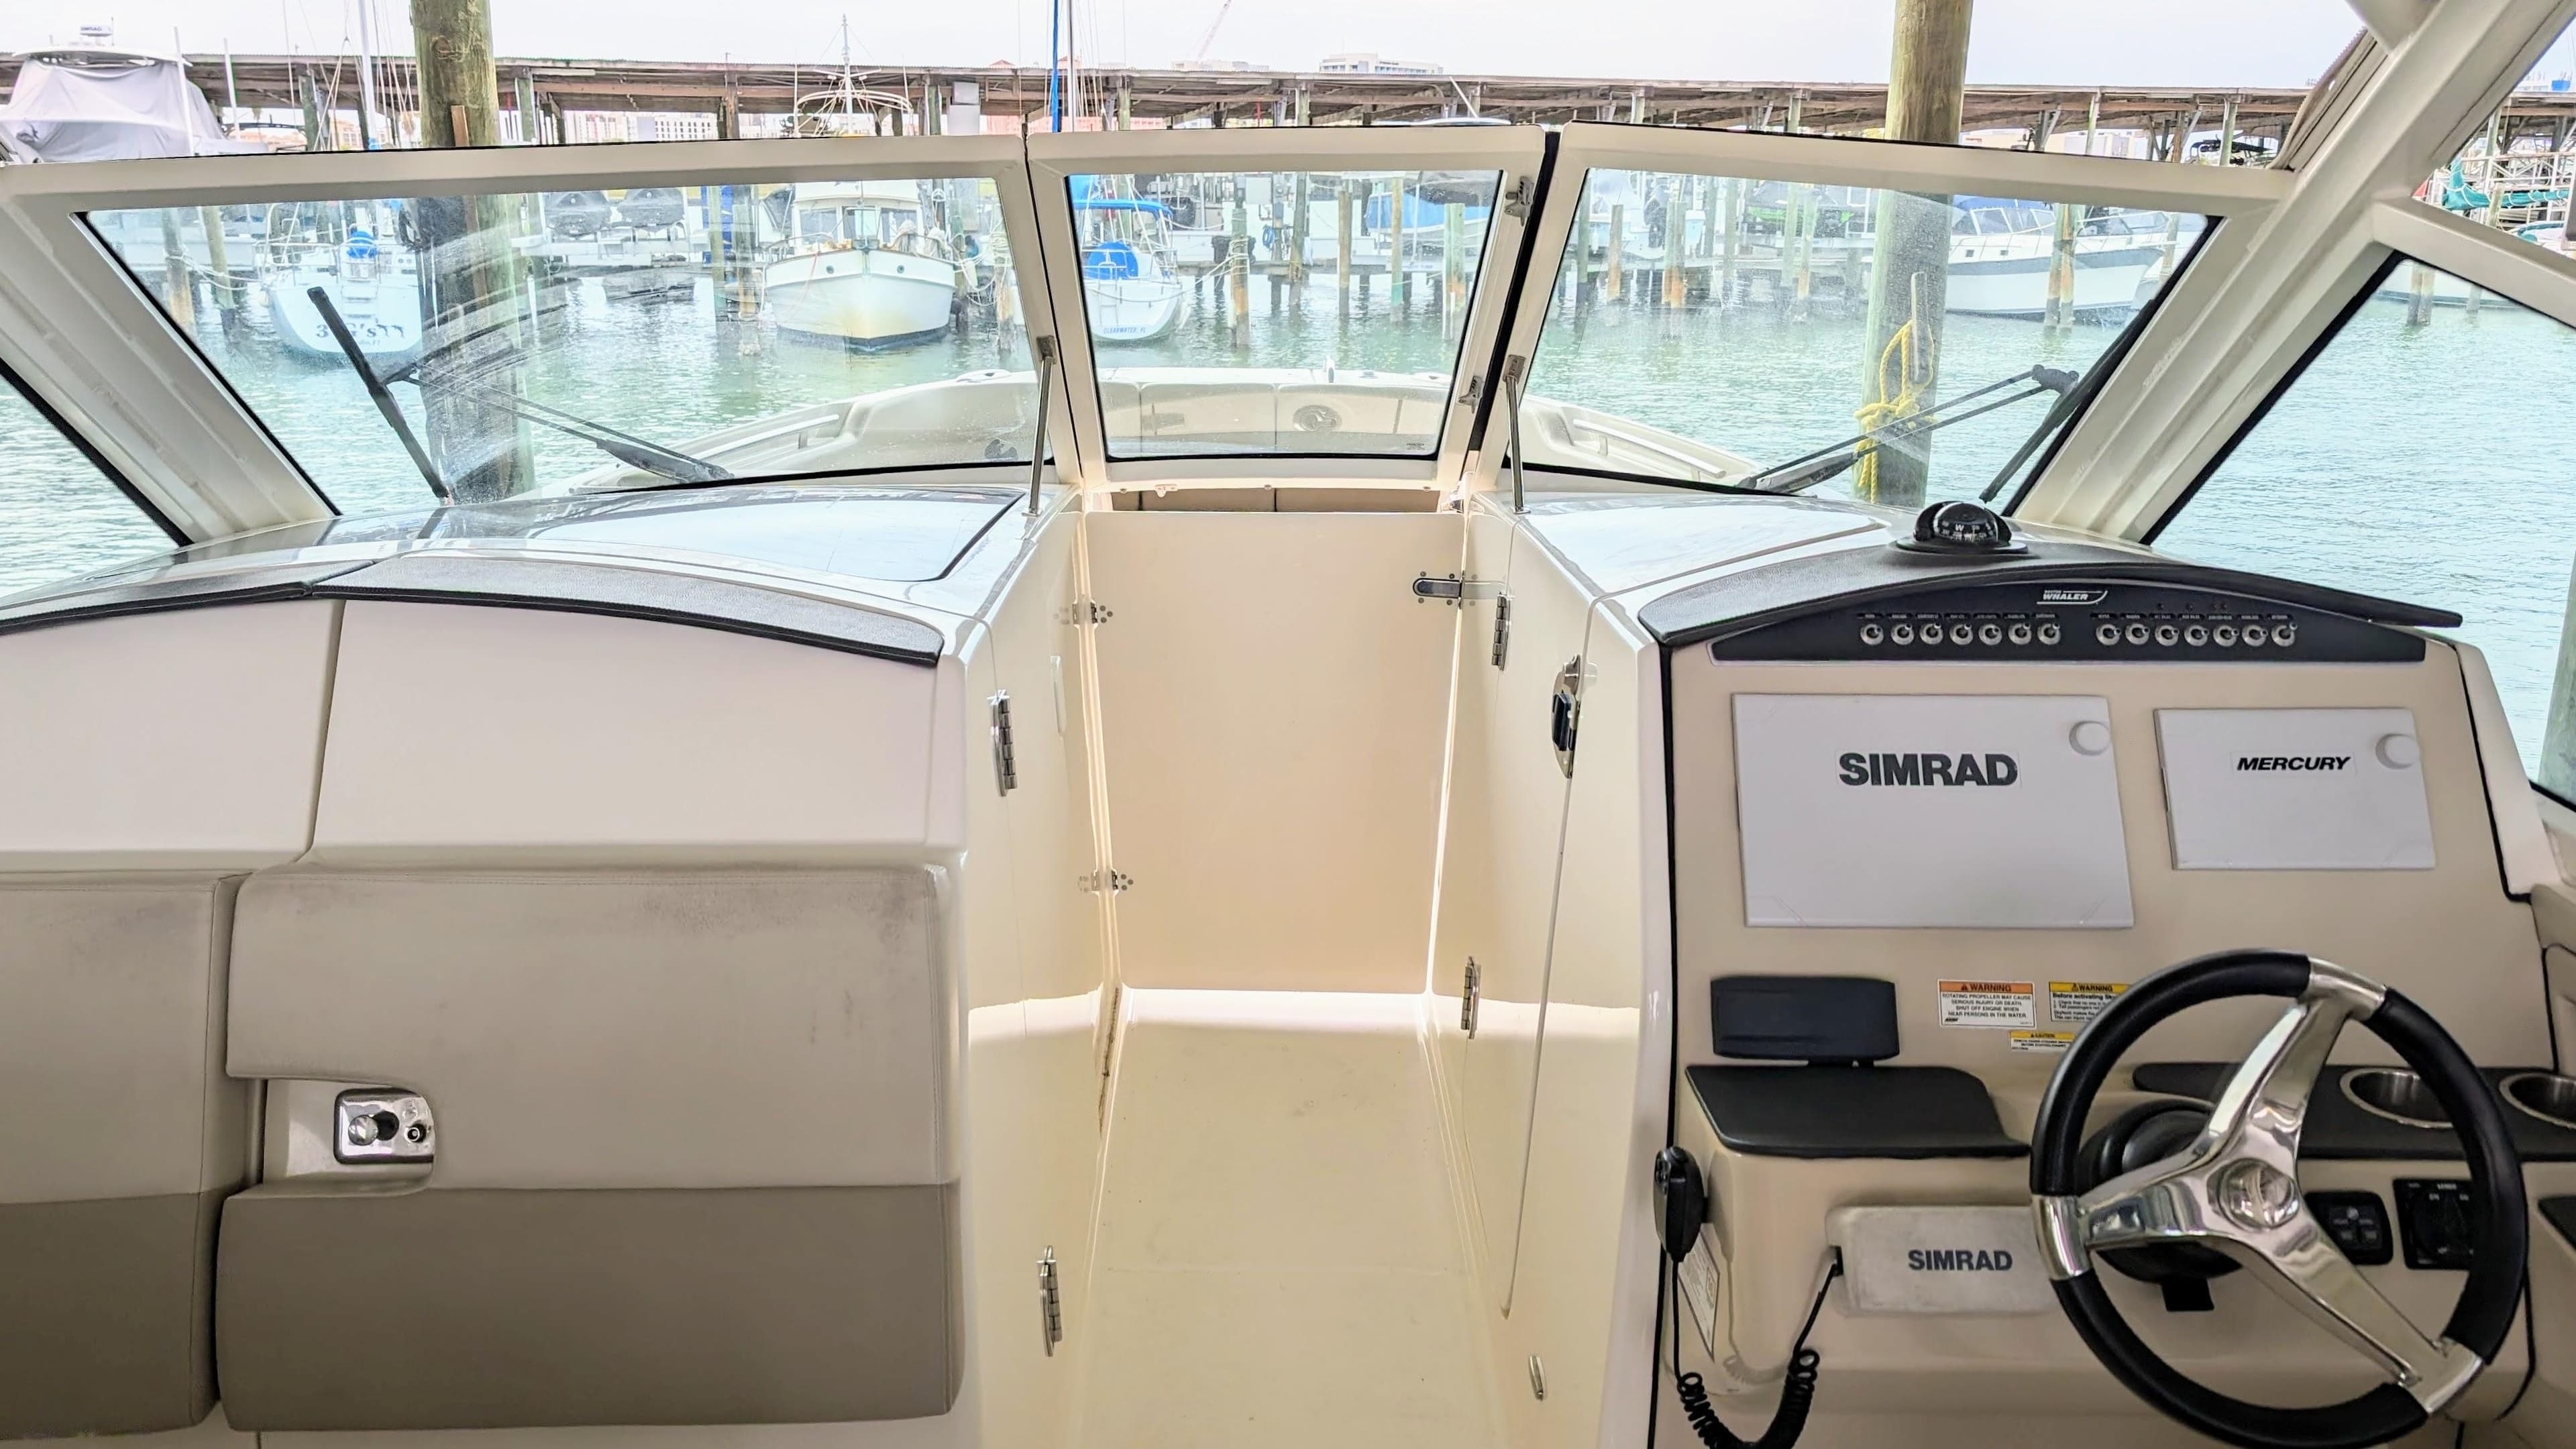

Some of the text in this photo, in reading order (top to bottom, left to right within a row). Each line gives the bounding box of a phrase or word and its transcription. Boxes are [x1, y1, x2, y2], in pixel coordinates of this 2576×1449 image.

[1839, 752, 2019, 786] SIMRAD
[2237, 756, 2351, 771] MERCURY
[1970, 983, 2012, 991] WARNING
[1908, 1248, 2013, 1271] SIMRAD
